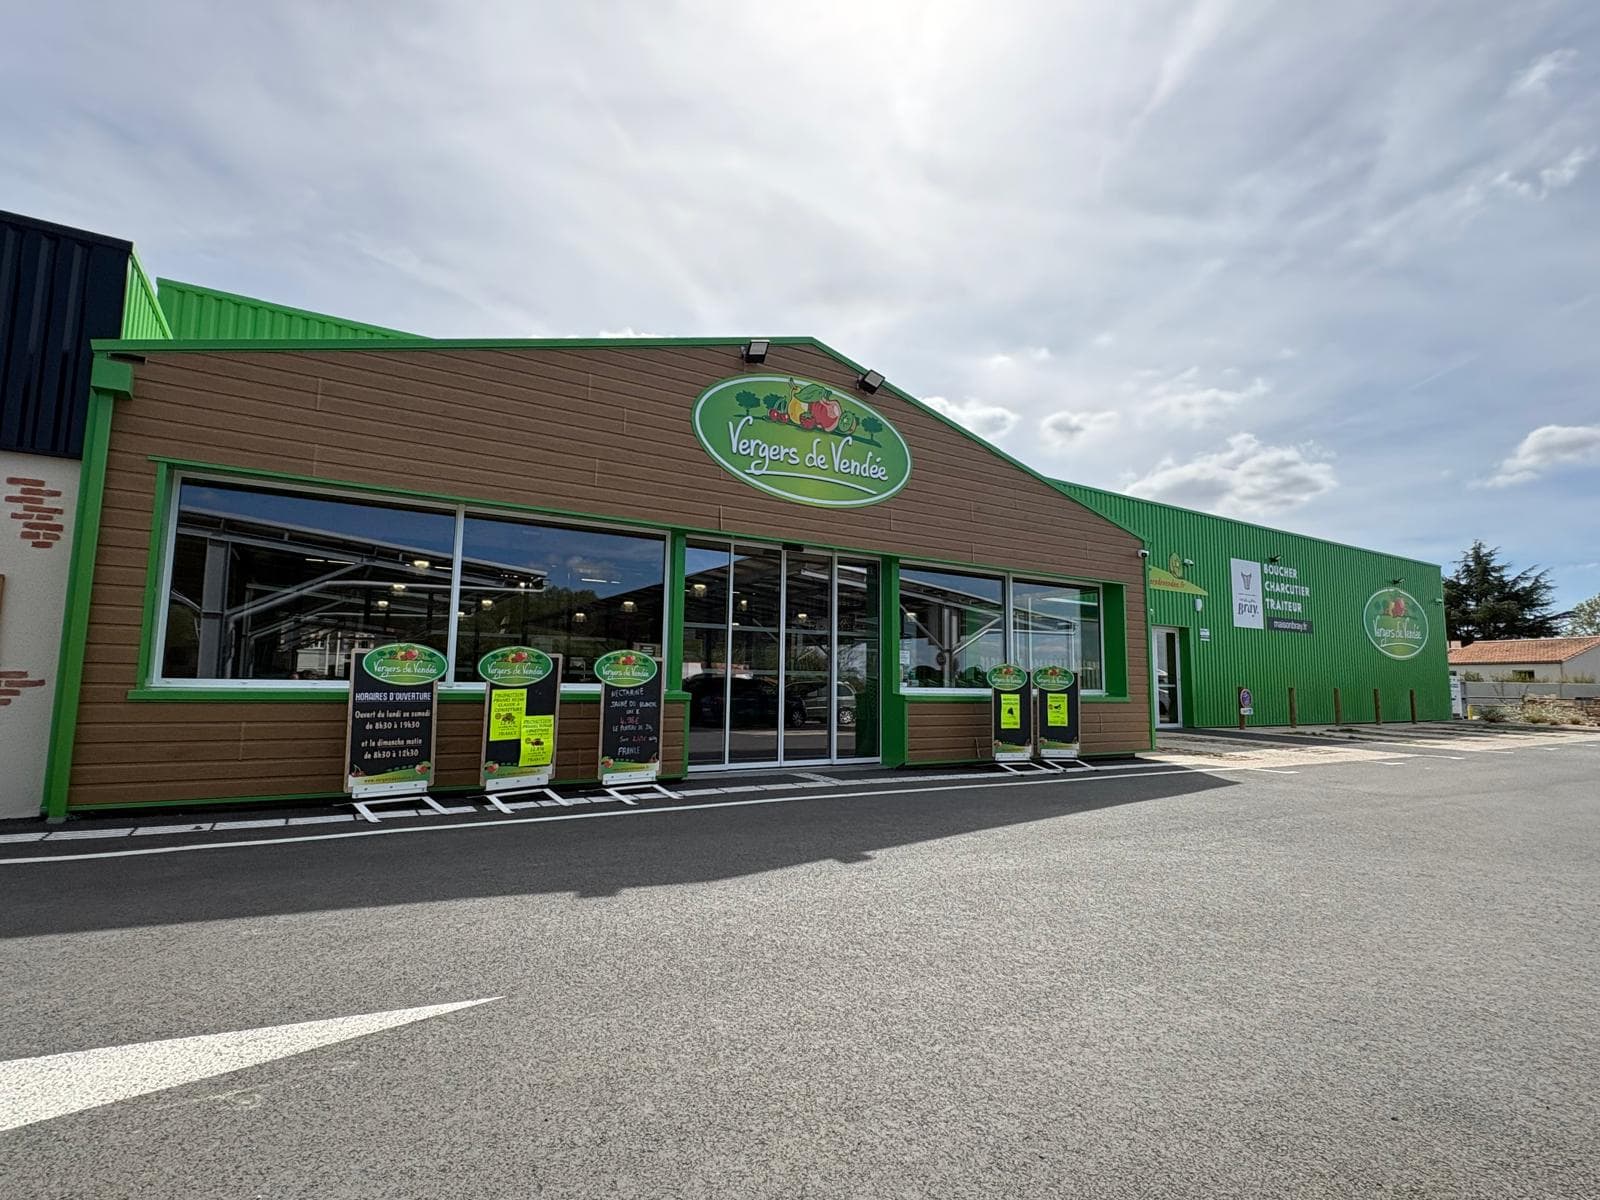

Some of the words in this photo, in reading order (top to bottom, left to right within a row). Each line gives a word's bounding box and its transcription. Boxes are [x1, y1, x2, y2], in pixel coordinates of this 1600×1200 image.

[728, 416, 800, 475] Vergers
[805, 438, 829, 469] de
[831, 436, 888, 480] Vendée
[1263, 563, 1297, 579] BOUCHER
[1264, 581, 1310, 597] CHARCUTIER
[1265, 598, 1302, 613] TRAITEUR
[1373, 614, 1396, 648] Vergers
[1396, 621, 1404, 638] de
[373, 659, 402, 678] Vergers
[402, 662, 413, 673] de
[413, 660, 438, 674] Vendée
[487, 661, 512, 679] Vergers
[512, 664, 521, 674] de
[602, 663, 623, 680] Vergers
[355, 692, 388, 701] HORAIRES
[389, 692, 432, 700] D'OUVERTURE
[354, 710, 376, 719] Ouvert
[377, 709, 385, 718] du
[386, 709, 402, 718] lundi
[411, 709, 431, 717] samedi
[365, 721, 373, 730] de
[374, 721, 393, 730] 8h30
[393, 721, 398, 729] à
[399, 720, 420, 729] 19h30
[369, 738, 376, 747] le
[377, 737, 405, 747] dimanche
[405, 737, 422, 745] matin
[363, 751, 372, 760] de
[373, 750, 391, 759] 8h30
[392, 750, 396, 758] à
[398, 748, 419, 758] 12h30
